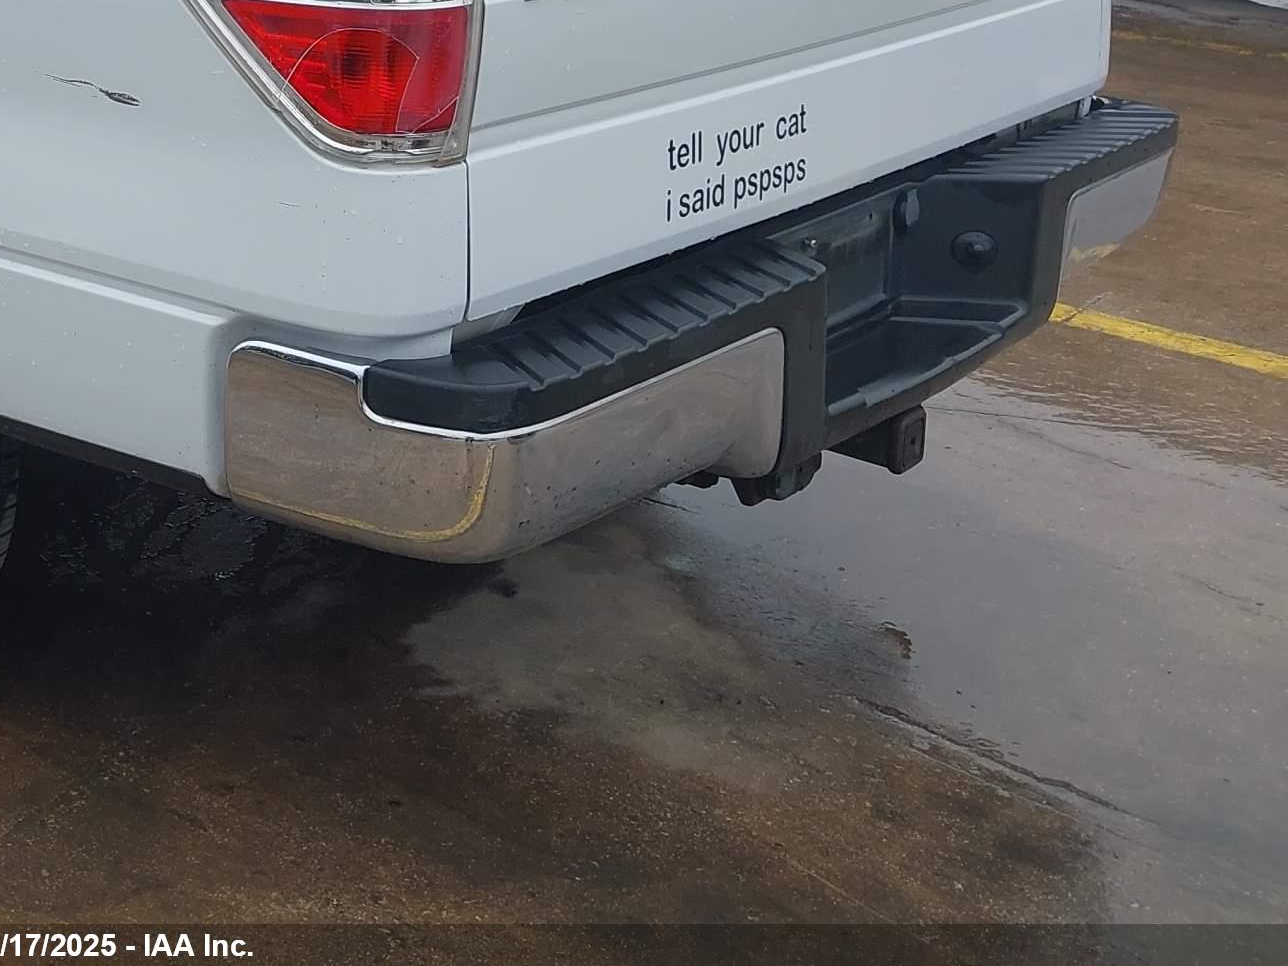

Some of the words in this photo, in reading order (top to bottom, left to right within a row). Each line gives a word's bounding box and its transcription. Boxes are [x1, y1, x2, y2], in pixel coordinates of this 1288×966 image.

[667, 130, 702, 171] tell
[715, 121, 765, 167] your
[775, 103, 807, 140] cat
[666, 189, 671, 222] i
[678, 173, 725, 218] said
[733, 158, 806, 209] pspsps
